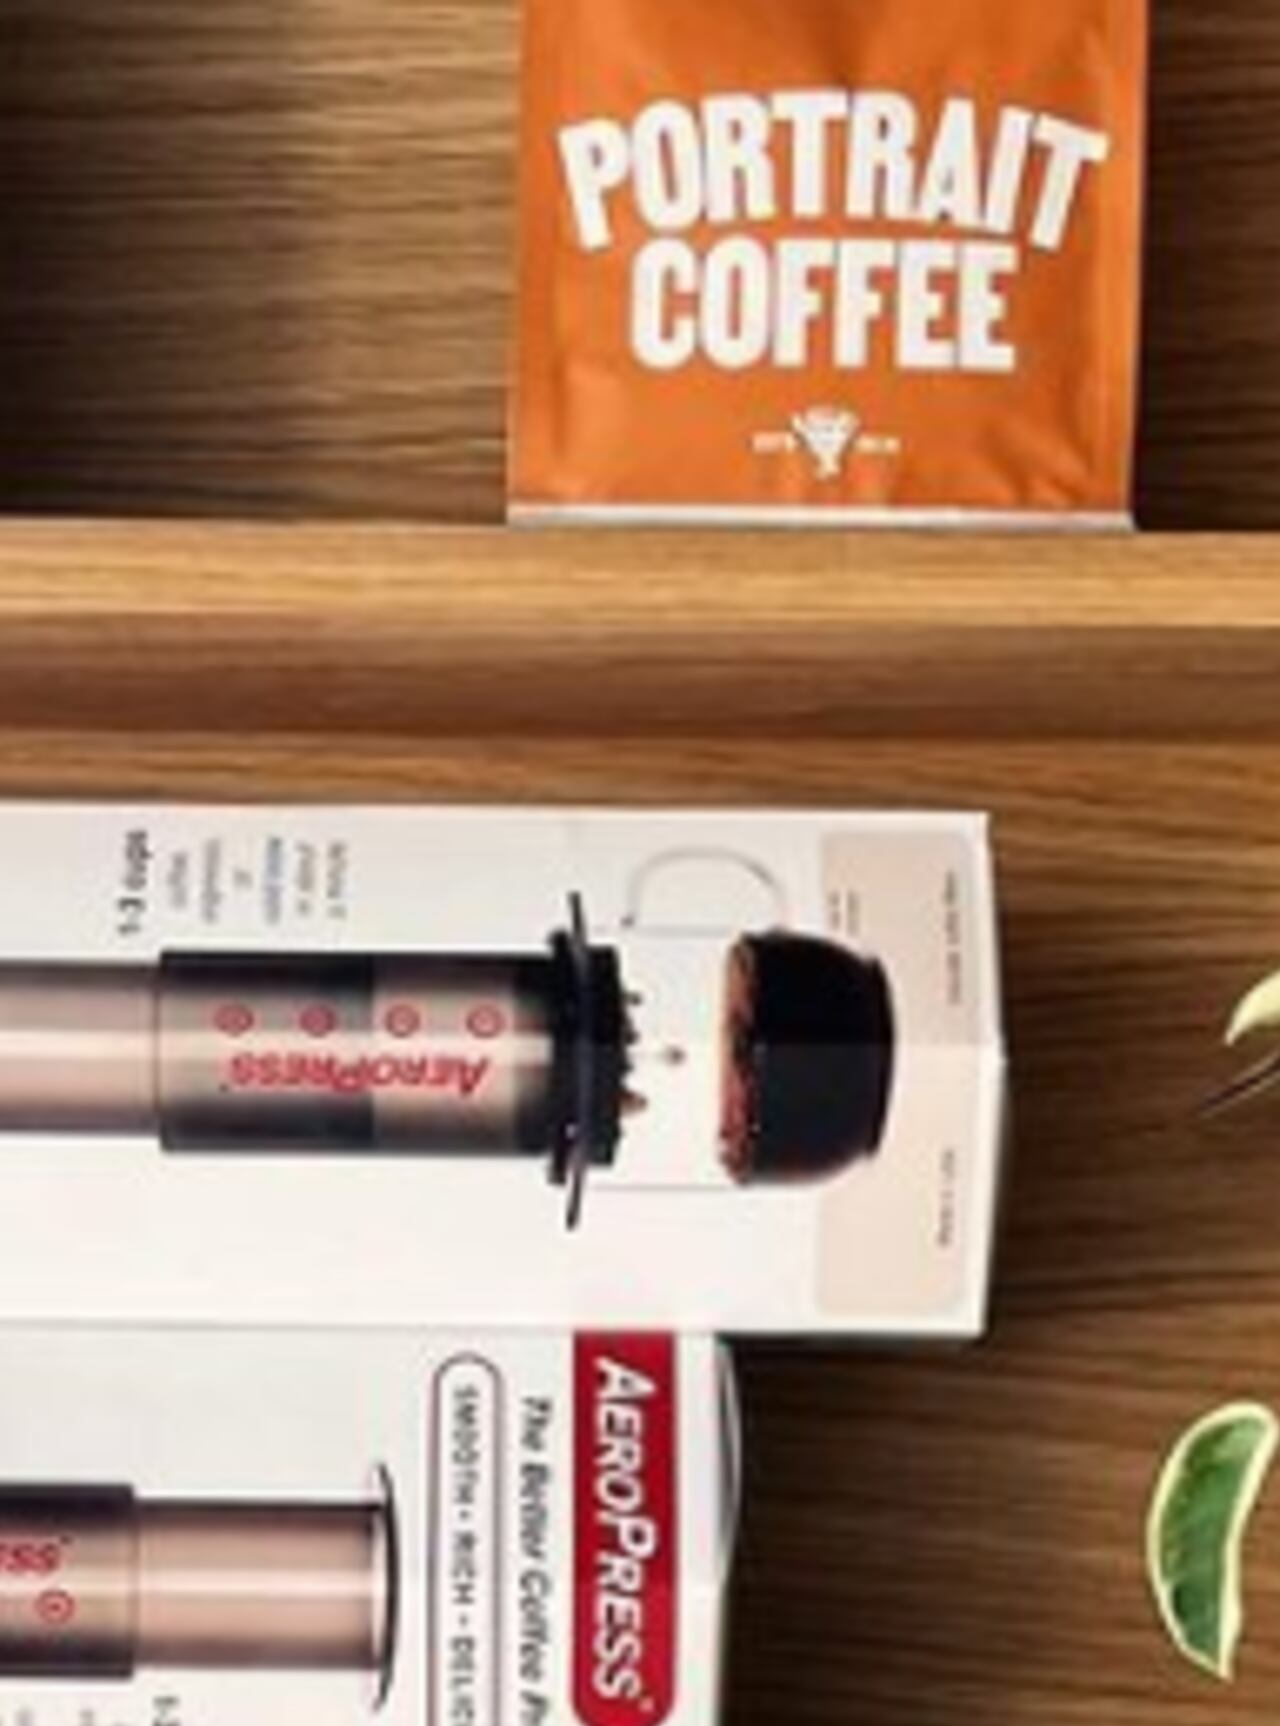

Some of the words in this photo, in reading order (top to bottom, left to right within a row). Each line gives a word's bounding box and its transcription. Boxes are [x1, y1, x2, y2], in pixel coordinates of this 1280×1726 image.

[558, 87, 1110, 253] PORTRAIT
[631, 236, 1016, 372] COFFEE
[451, 1385, 479, 1505] SMOOTH
[521, 1396, 553, 1452] The
[452, 1529, 477, 1605] RICH
[520, 1462, 550, 1560] Better
[520, 1569, 552, 1684] Coffee
